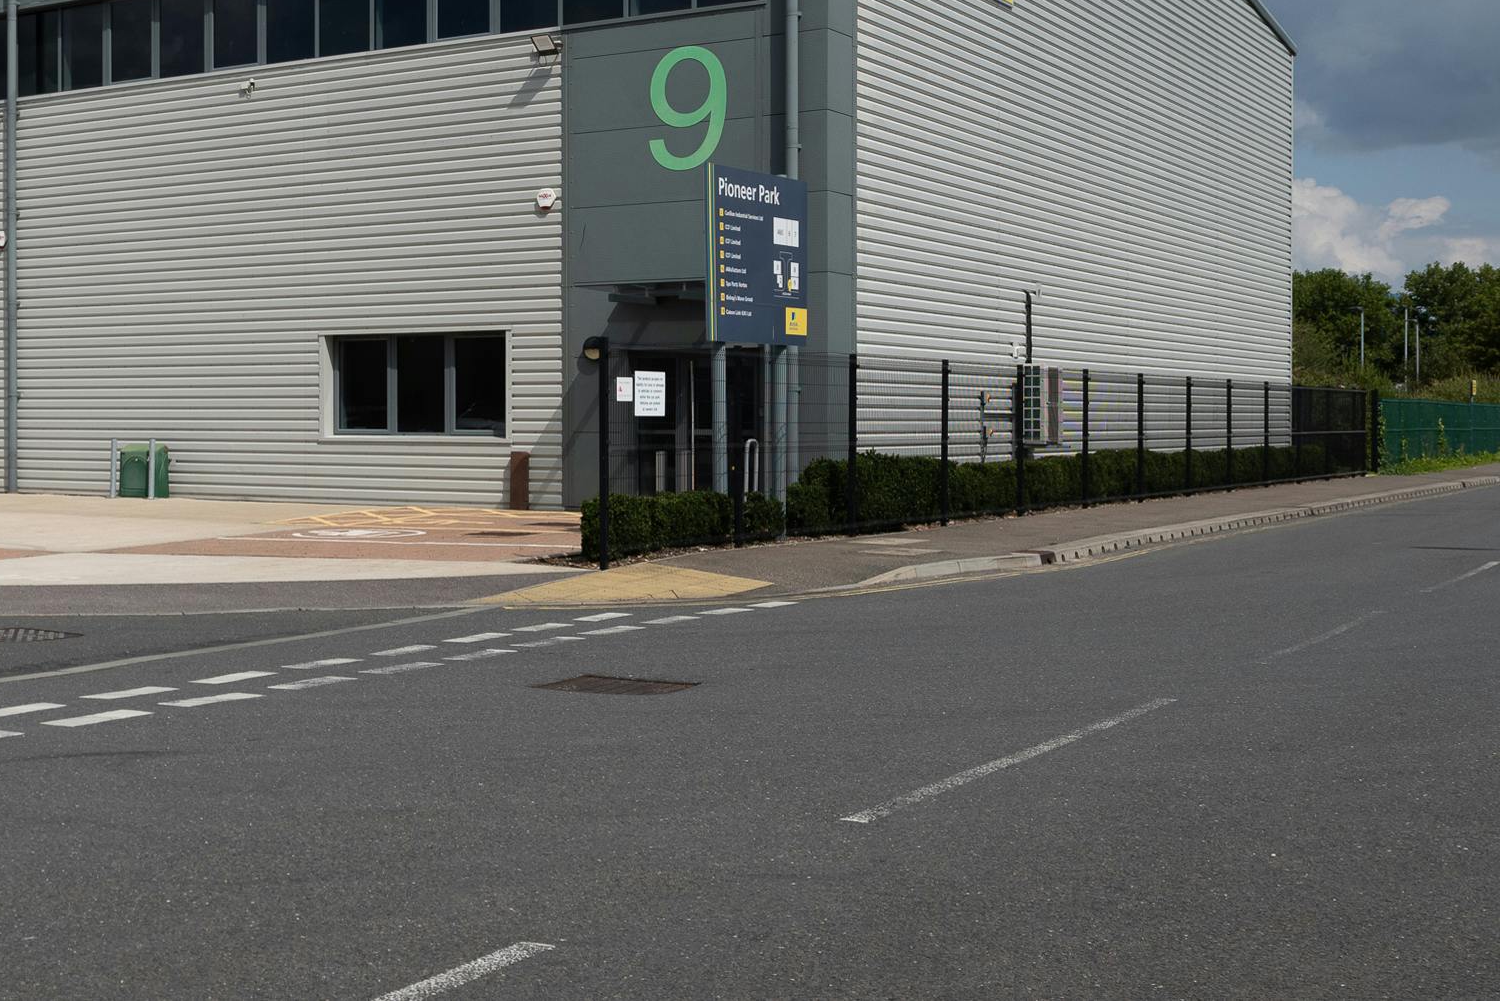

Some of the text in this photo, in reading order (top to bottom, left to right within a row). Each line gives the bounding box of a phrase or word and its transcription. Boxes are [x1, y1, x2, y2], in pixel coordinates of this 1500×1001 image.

[648, 45, 727, 171] 9
[718, 177, 781, 206] Pioneer Park
